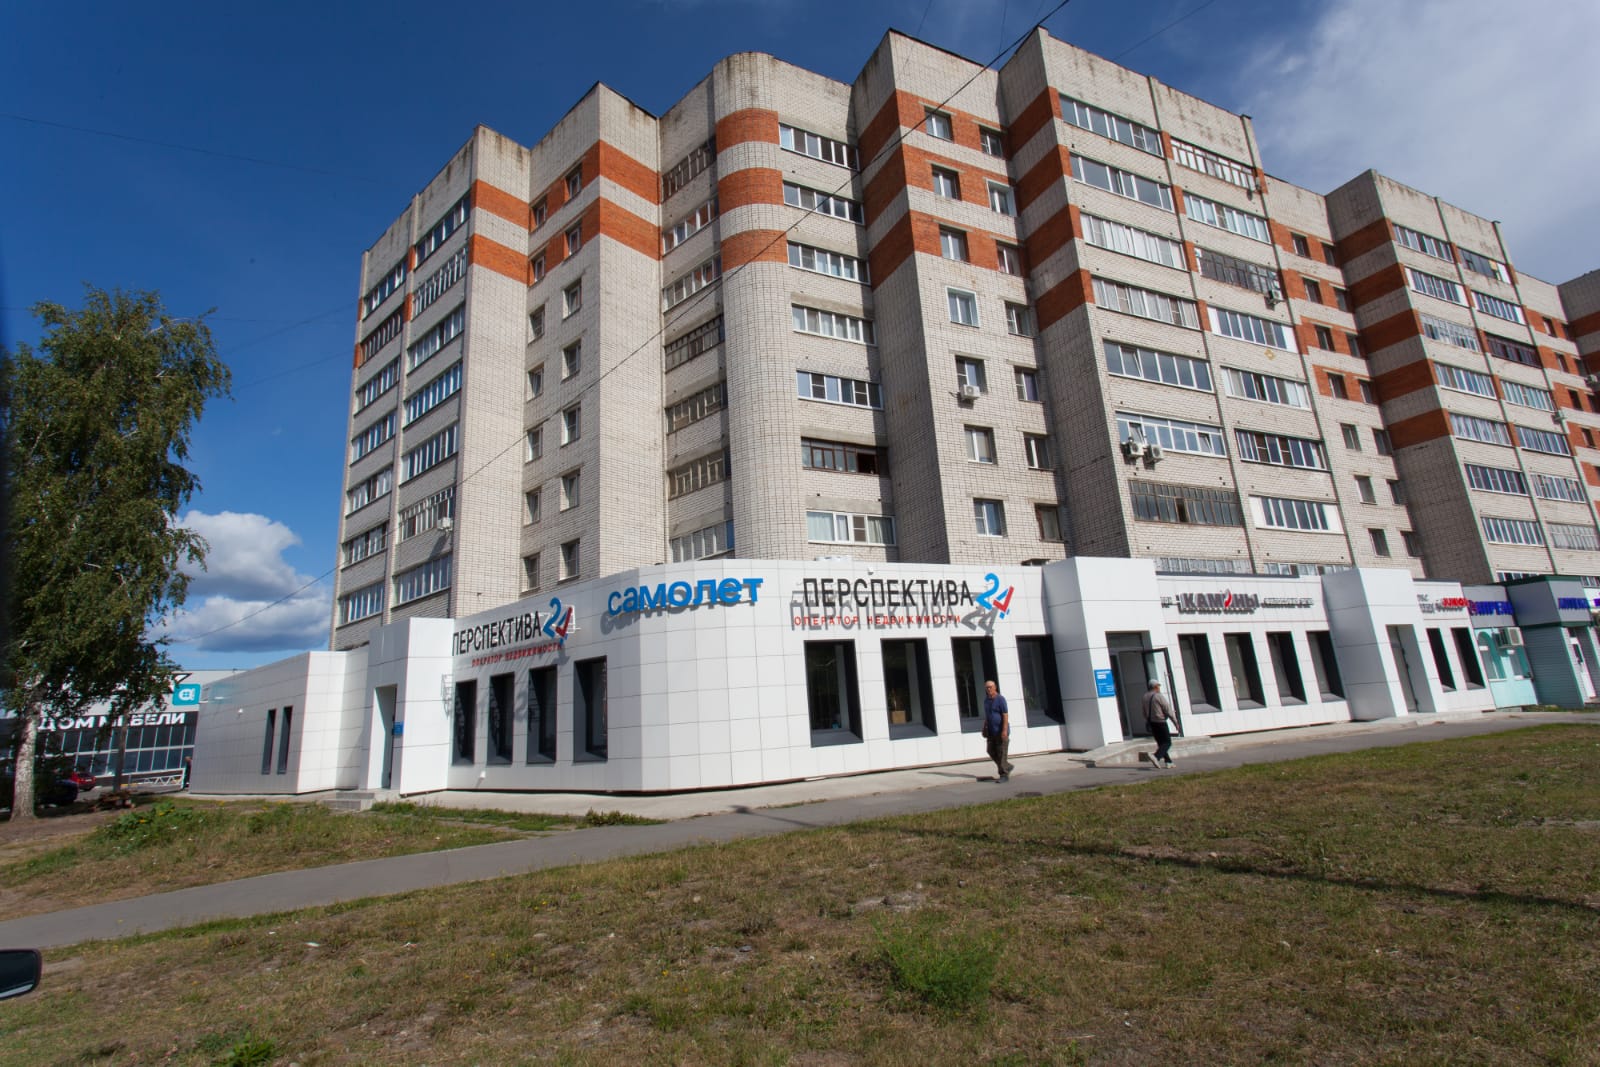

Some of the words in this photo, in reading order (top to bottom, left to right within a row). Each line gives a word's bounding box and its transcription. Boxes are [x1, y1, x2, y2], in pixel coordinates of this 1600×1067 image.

[607, 577, 764, 616] самолет
[802, 578, 973, 607] ПЕРСПЕКТИВА
[452, 611, 542, 656] ПЕРСПЕКТИВА
[794, 615, 859, 626] ОПЕРАТОР
[867, 615, 962, 626] НЕДВИЖИМОСТИ
[37, 717, 94, 731] ДОМ
